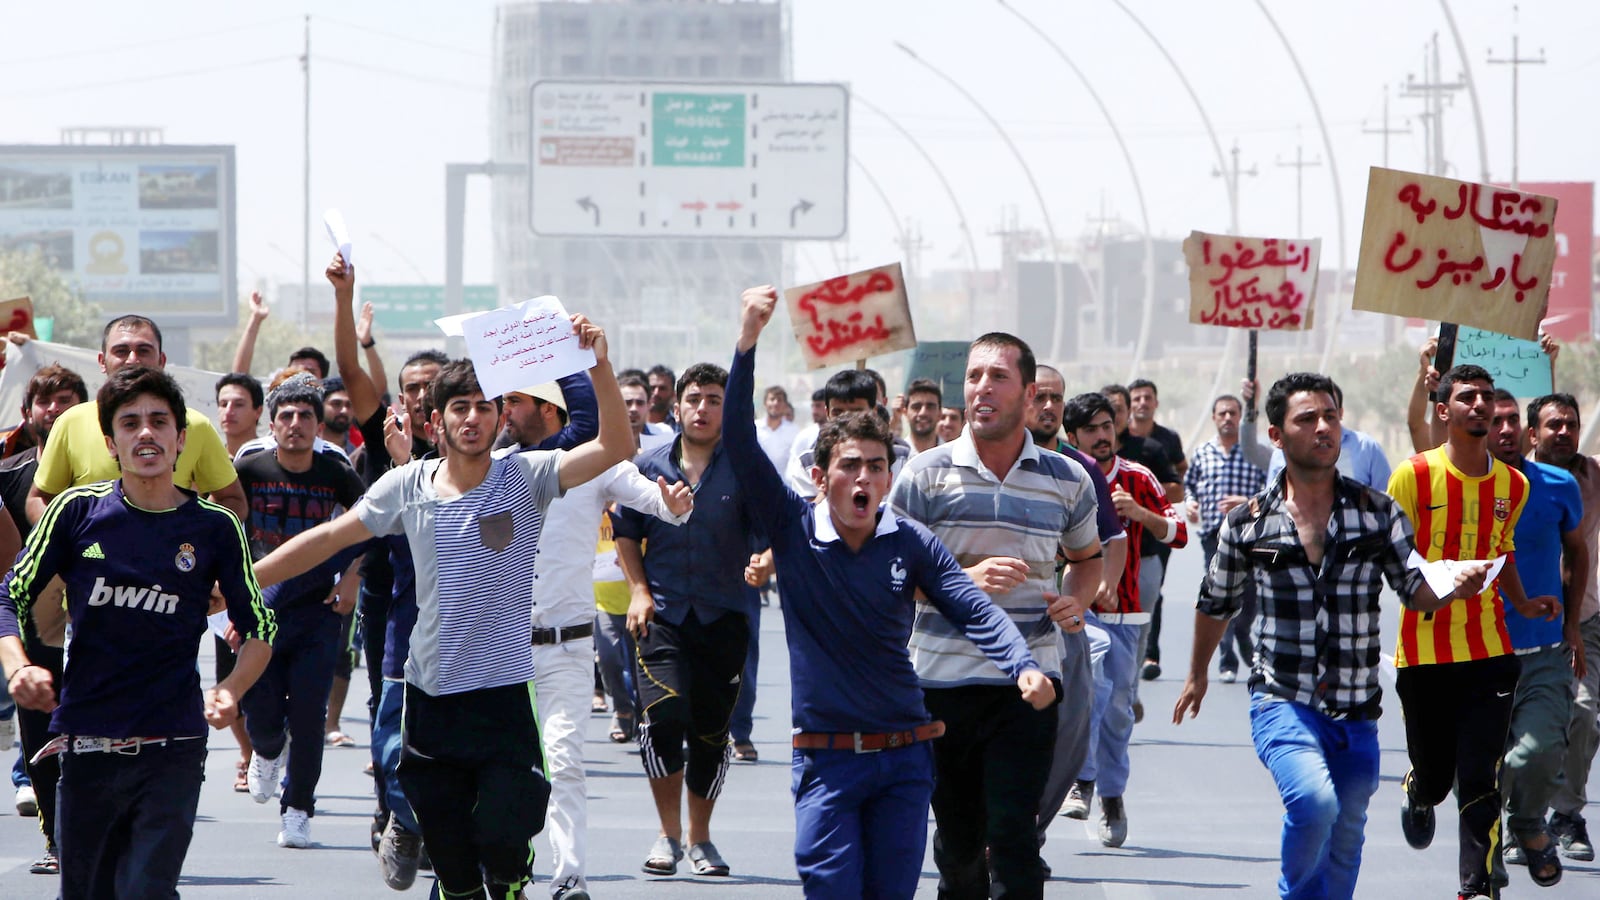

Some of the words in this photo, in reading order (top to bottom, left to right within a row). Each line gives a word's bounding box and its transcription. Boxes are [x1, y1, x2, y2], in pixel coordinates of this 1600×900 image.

[674, 115, 724, 128] MOSUL
[250, 481, 307, 496] PANAMA
[309, 486, 336, 498] CITY
[1458, 498, 1481, 525] 10
[599, 526, 611, 541] 10
[1432, 531, 1498, 551] QATAR
[88, 577, 180, 615] bwin
